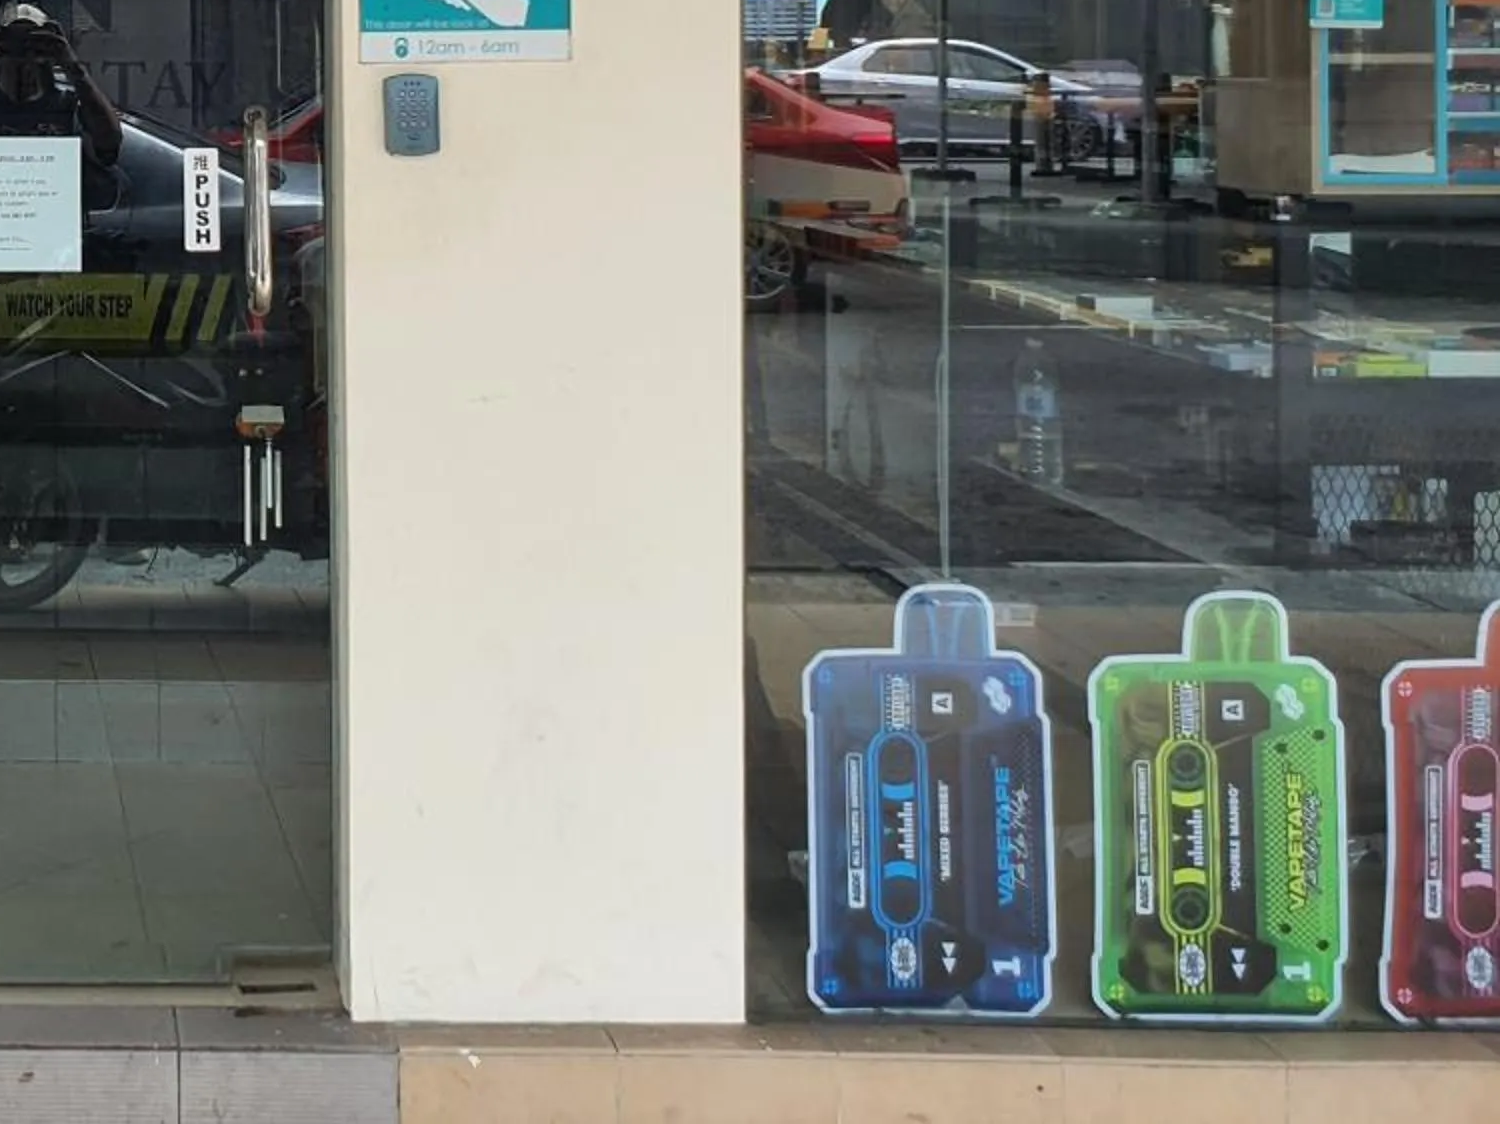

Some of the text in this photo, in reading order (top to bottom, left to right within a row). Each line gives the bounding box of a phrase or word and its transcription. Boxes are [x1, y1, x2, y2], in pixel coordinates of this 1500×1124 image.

[417, 39, 466, 55] 12am
[481, 39, 520, 54] 6am
[196, 175, 211, 244] PUSH
[6, 292, 133, 318] WATCH YOUR STEP
[995, 766, 1015, 906] VAPETAPE
[1287, 774, 1306, 912] VAPETAPE
[993, 956, 1020, 977] 1
[1283, 961, 1311, 980] 1
